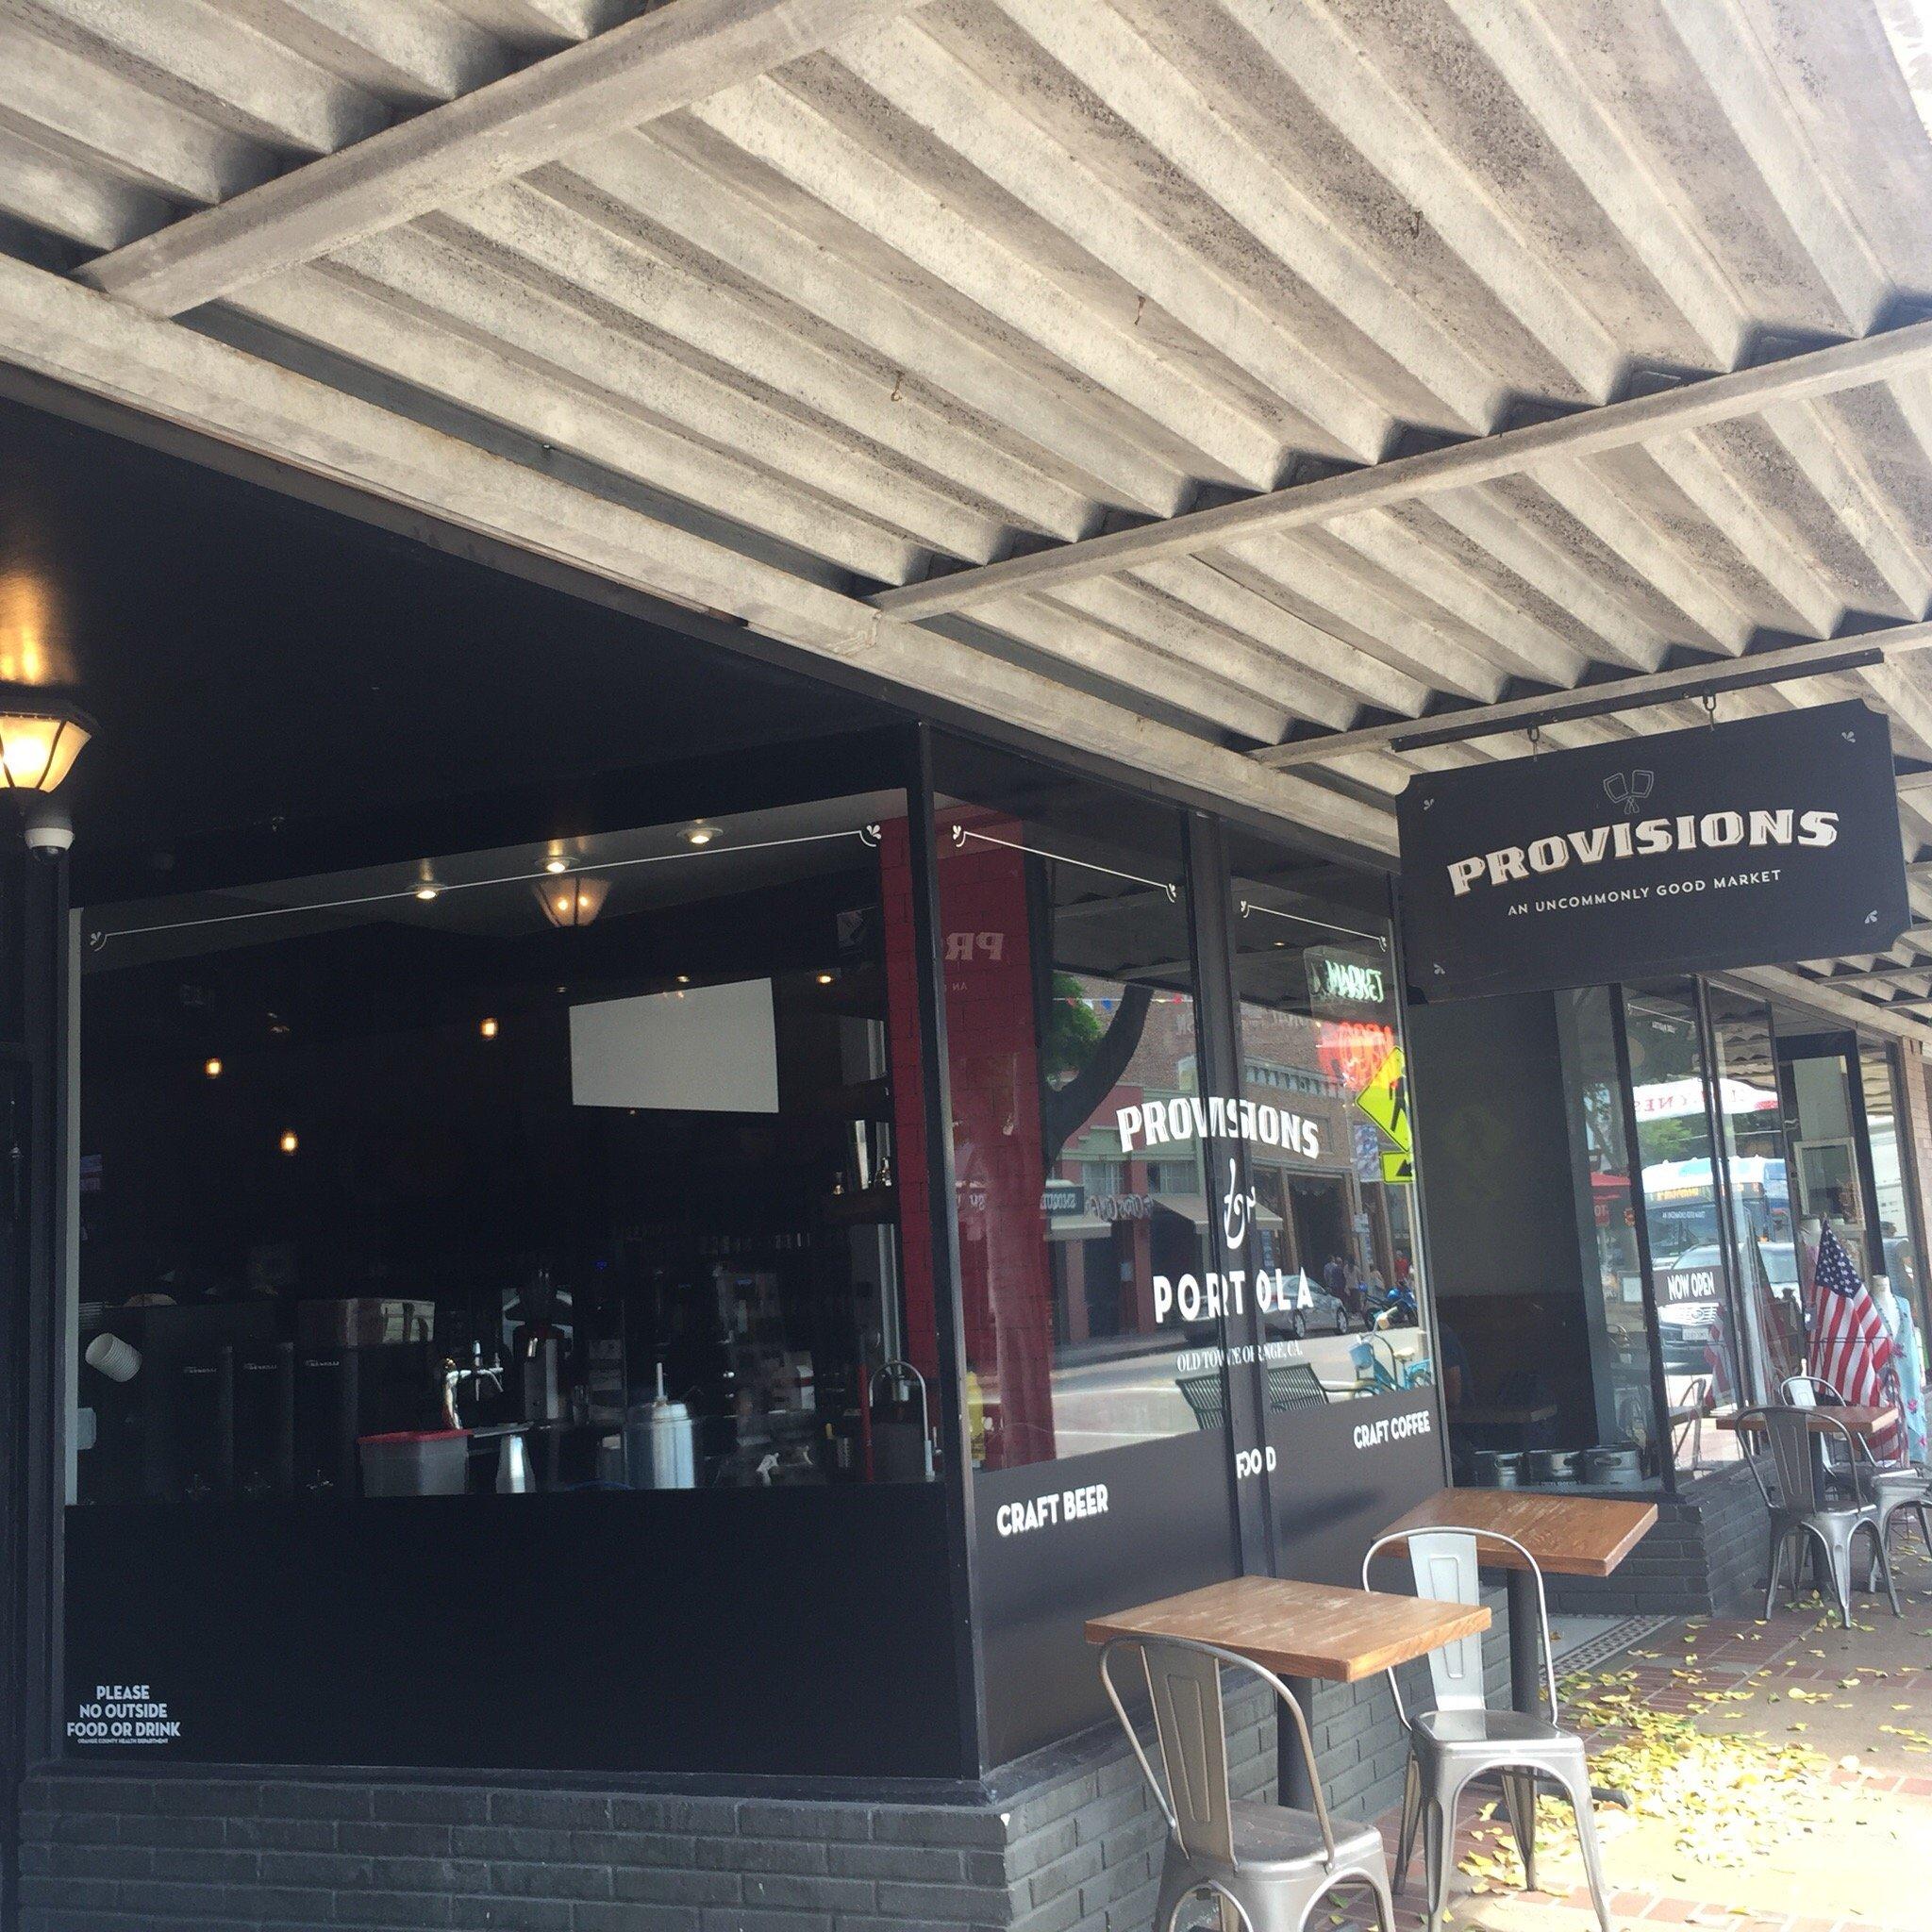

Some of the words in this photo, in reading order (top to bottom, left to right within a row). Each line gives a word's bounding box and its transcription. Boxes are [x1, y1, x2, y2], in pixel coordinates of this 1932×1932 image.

[1447, 808, 1840, 897] PROVISIONS
[1507, 903, 1528, 916] AN
[1535, 887, 1650, 912] UNCOMMONLY
[1656, 879, 1707, 896] GOOD
[1713, 869, 1782, 889] MARKET
[1116, 1096, 1320, 1159] PROVISIONS
[1152, 1267, 1314, 1324] PORTOLA
[1667, 1274, 1690, 1301] NOW
[1690, 1271, 1716, 1298] OPEN
[1176, 1352, 1201, 1372] OLD
[1353, 1419, 1390, 1450] CRAFT
[1390, 1409, 1432, 1441] COFFEE
[996, 1492, 1060, 1537] CRAFT
[1062, 1483, 1109, 1522] BEER
[79, 1703, 103, 1719] NO
[104, 1703, 168, 1719] OUTSIDE
[96, 1684, 150, 1700] PLEASE
[67, 1722, 108, 1737] FOOD
[110, 1722, 133, 1737] OR
[135, 1721, 181, 1737] DRINK
